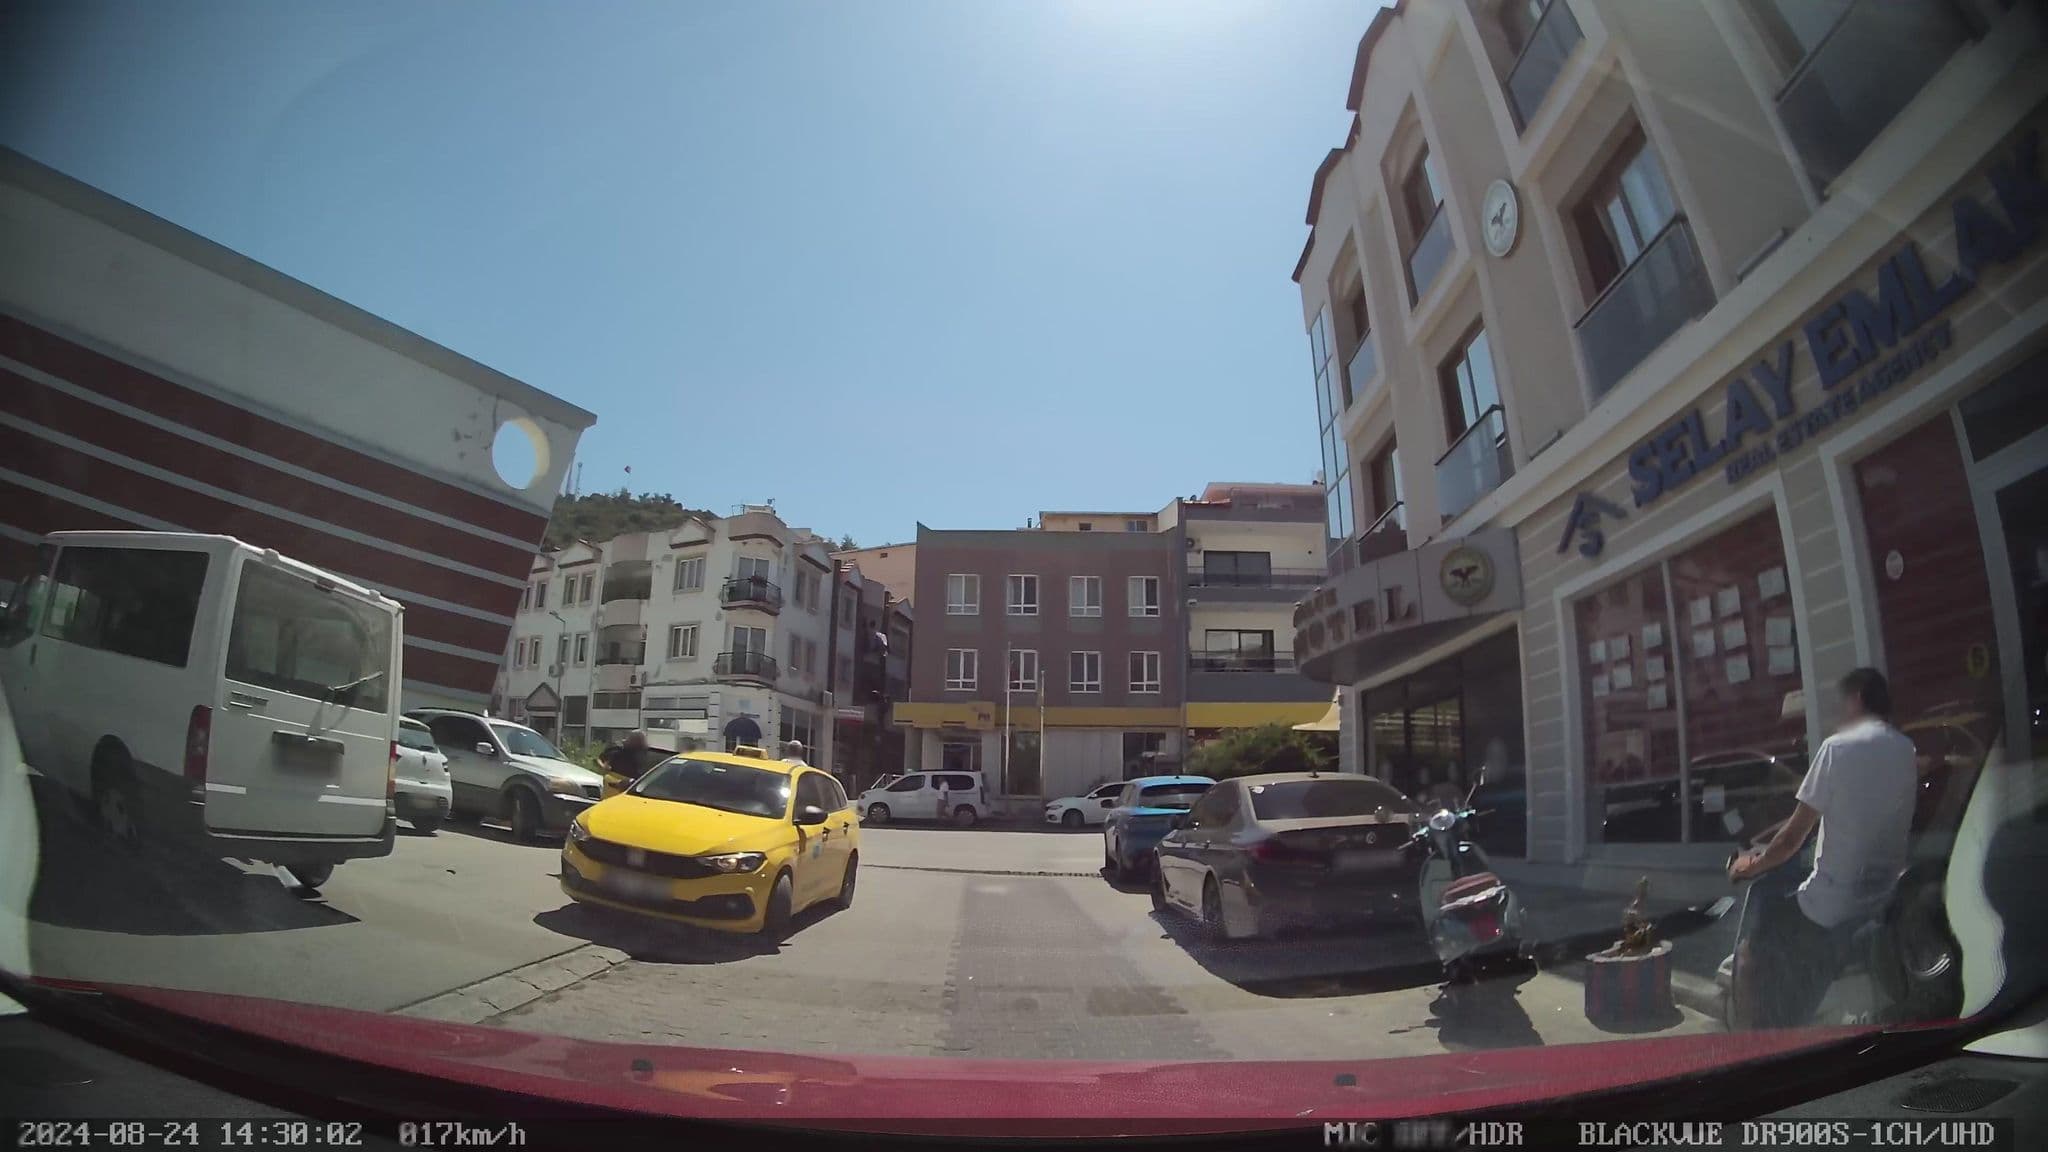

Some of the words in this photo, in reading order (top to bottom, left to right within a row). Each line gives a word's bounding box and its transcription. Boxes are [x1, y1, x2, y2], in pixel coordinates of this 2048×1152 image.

[1628, 339, 1796, 508] SELAY
[1804, 128, 2048, 390] EMLAK
[1726, 443, 1777, 485] REAL
[1777, 391, 1859, 453] ESTATE
[1859, 319, 1952, 404] AGENCY
